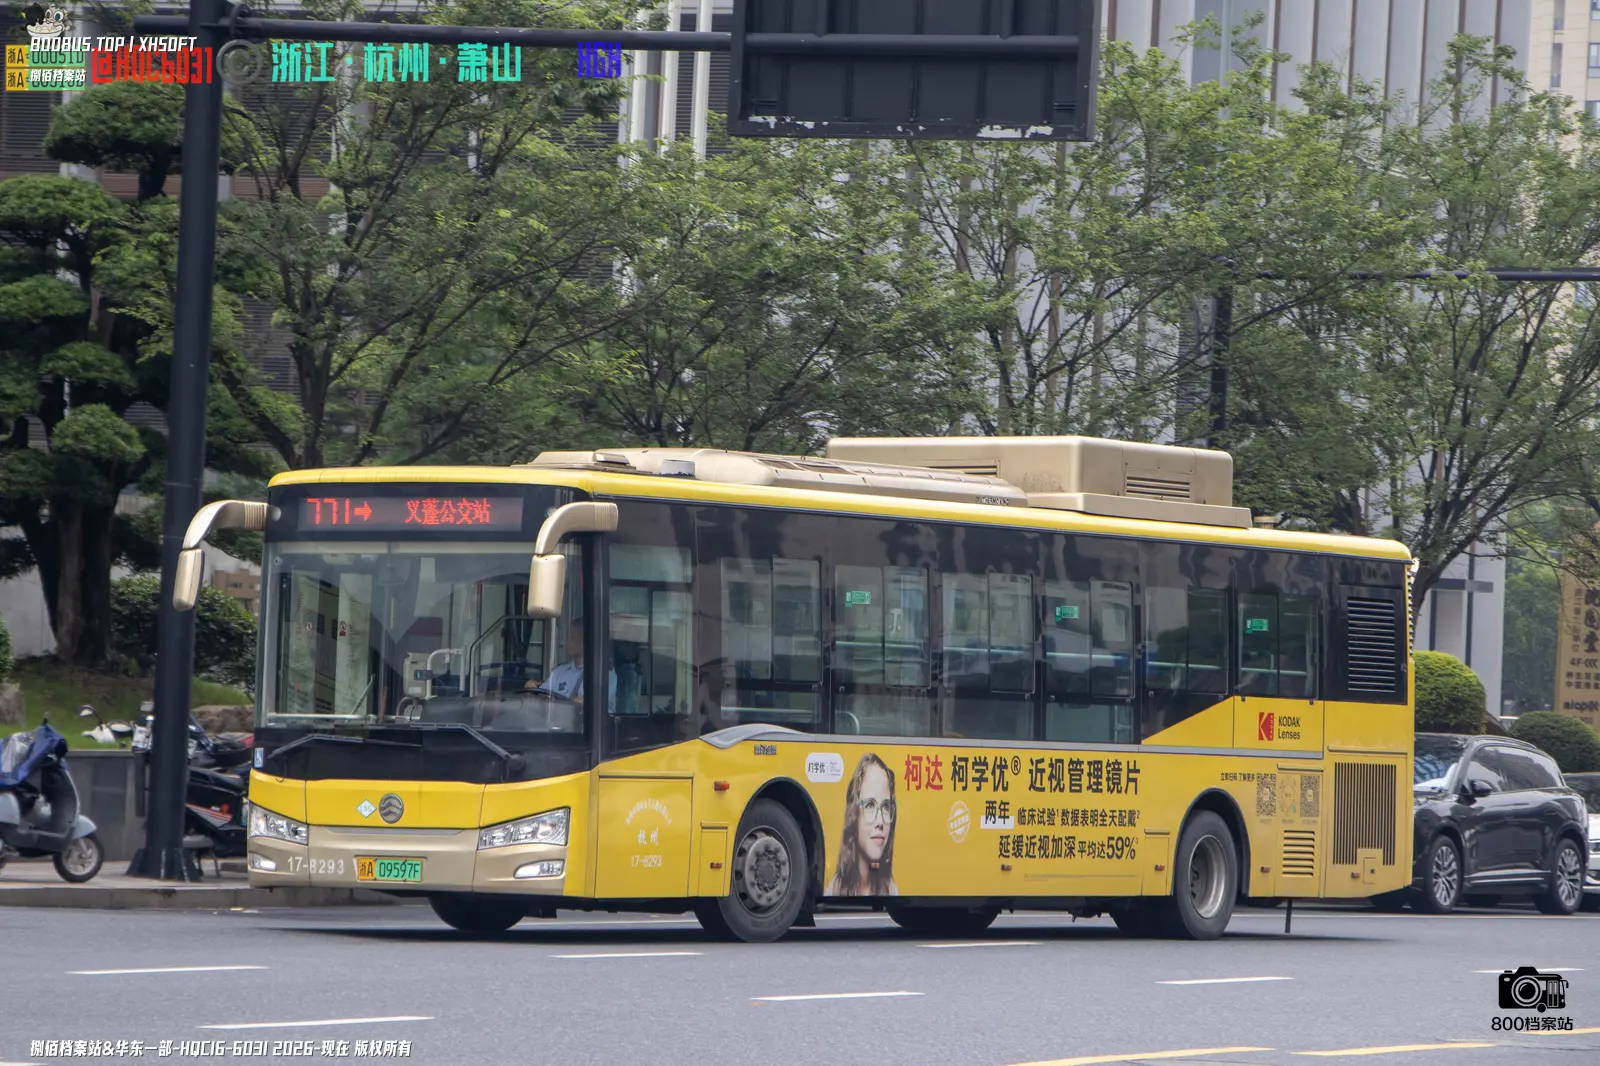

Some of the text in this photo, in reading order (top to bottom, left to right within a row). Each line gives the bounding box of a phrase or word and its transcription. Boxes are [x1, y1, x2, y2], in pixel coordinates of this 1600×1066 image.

[307, 497, 491, 525] 771 义蓬公交站
[1278, 716, 1301, 728] KODAK
[1278, 728, 1301, 740] Lenses
[904, 753, 943, 792] 柯达
[1028, 757, 1141, 795] 近视管理镜片
[985, 800, 1010, 826] 两年
[287, 856, 345, 876] 17-8293
[631, 855, 663, 868] 17-8293
